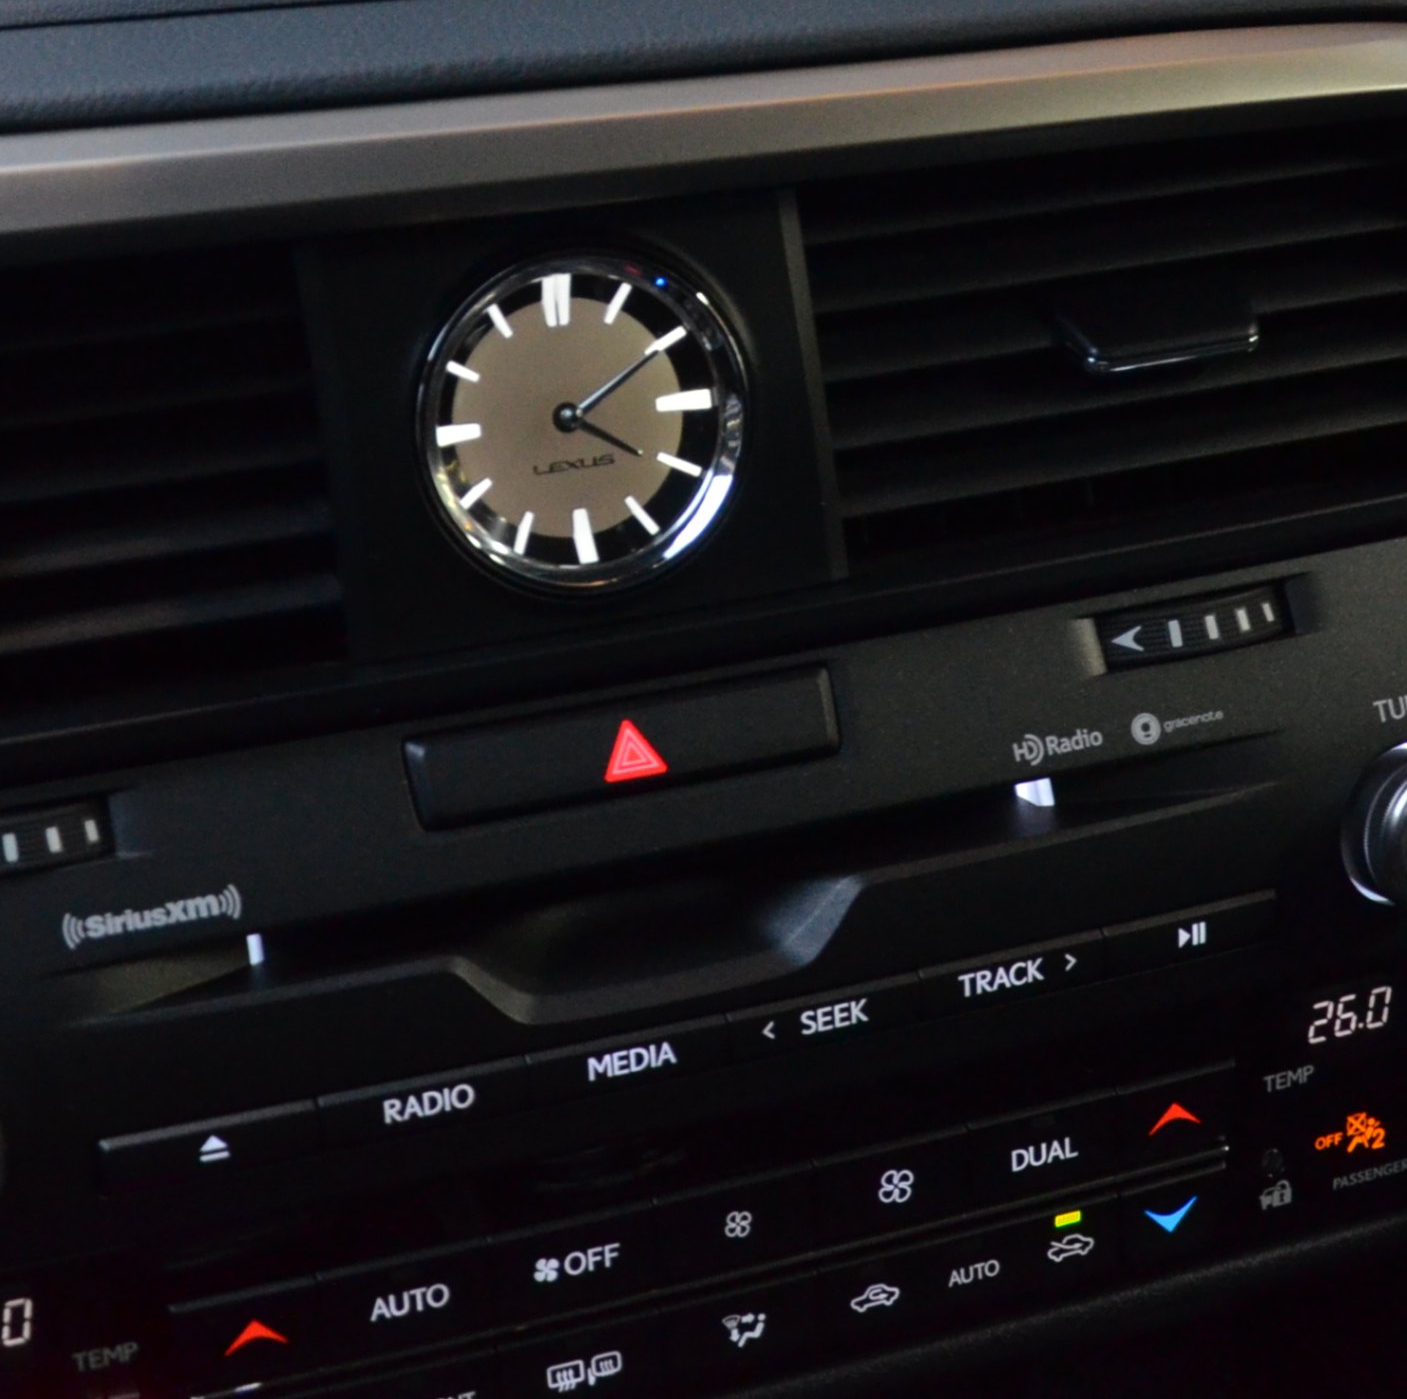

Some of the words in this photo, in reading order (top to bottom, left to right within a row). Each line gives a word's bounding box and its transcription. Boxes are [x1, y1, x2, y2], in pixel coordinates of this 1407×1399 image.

[533, 453, 615, 476] LEXUS
[1045, 728, 1103, 757] Radio
[958, 958, 1046, 998] TRACK
[800, 999, 870, 1036] SEEK
[1308, 986, 1393, 1044] 26.0
[587, 1041, 678, 1082] MEDIA
[1263, 1065, 1315, 1093] TEMP
[383, 1083, 476, 1124] RADIO
[1011, 1137, 1079, 1172] DUAL
[1314, 1132, 1343, 1151] OFF
[563, 1243, 621, 1276] OFF
[948, 1259, 1001, 1288] AUTO
[370, 1283, 450, 1322] AUTO
[72, 1342, 139, 1372] TEMP
